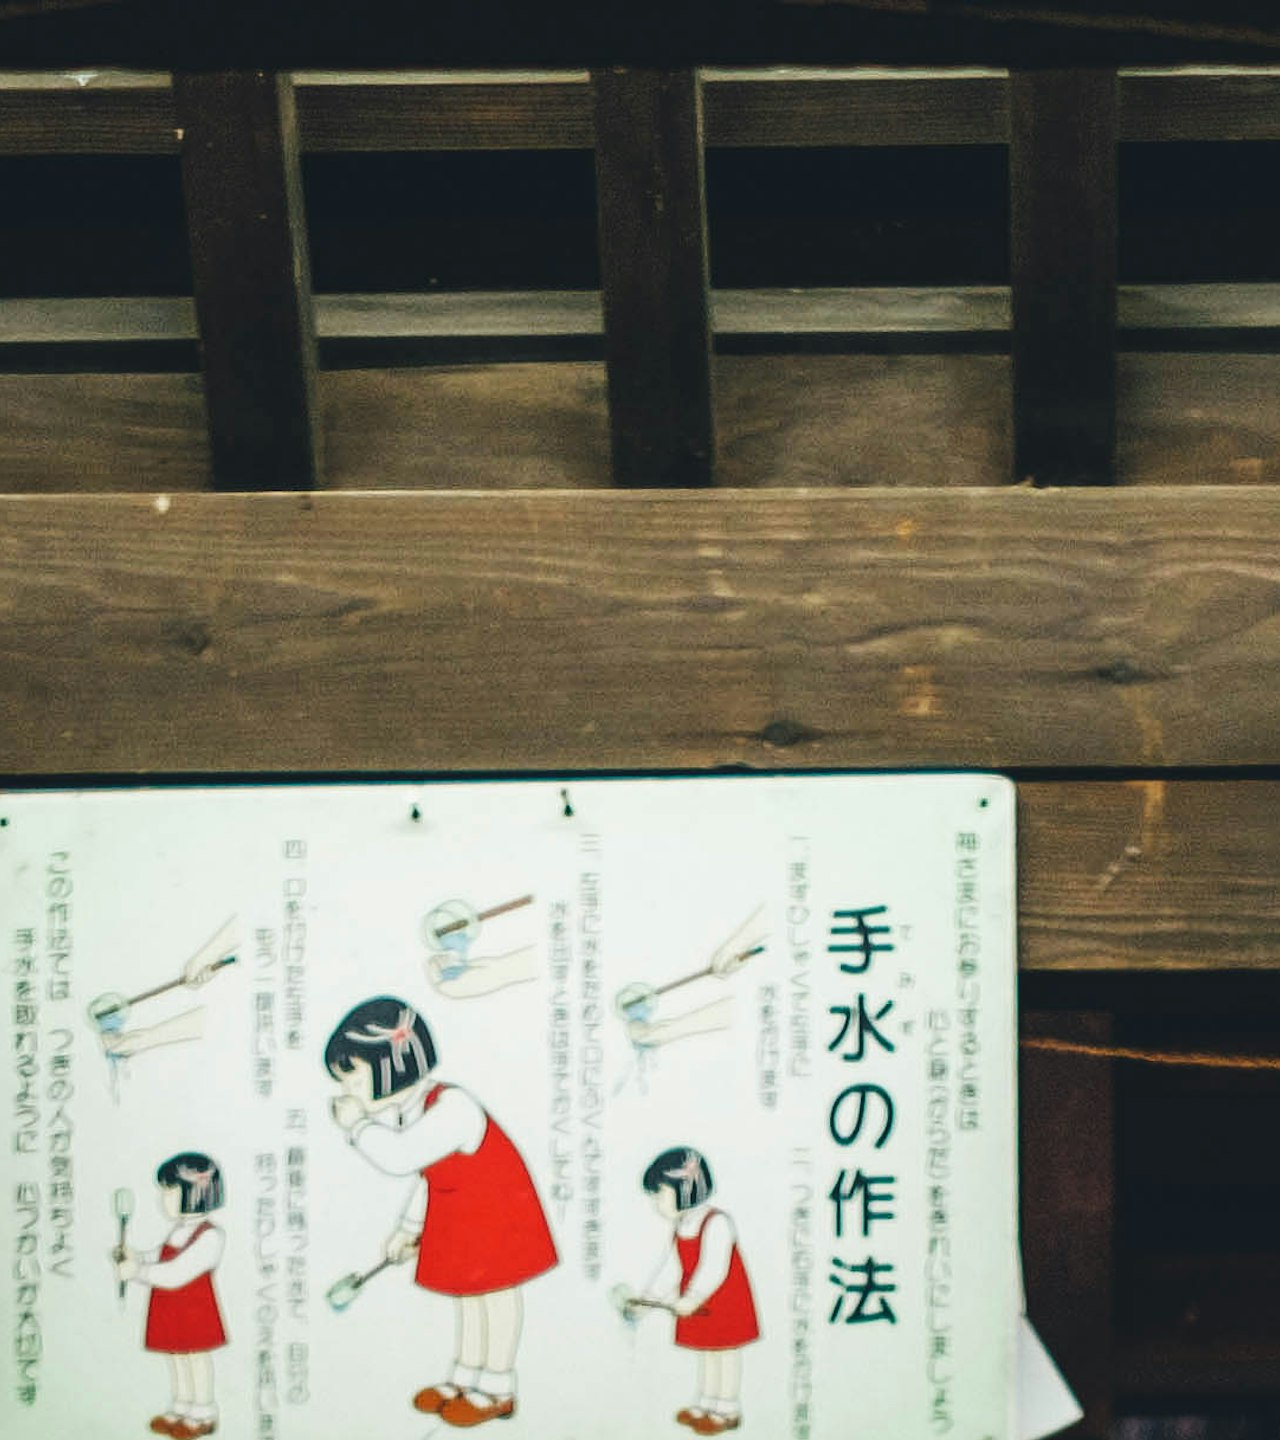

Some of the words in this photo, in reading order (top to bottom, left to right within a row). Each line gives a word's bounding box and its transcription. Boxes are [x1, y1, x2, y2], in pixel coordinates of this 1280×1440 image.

[826, 903, 896, 1326] 手水の作法
